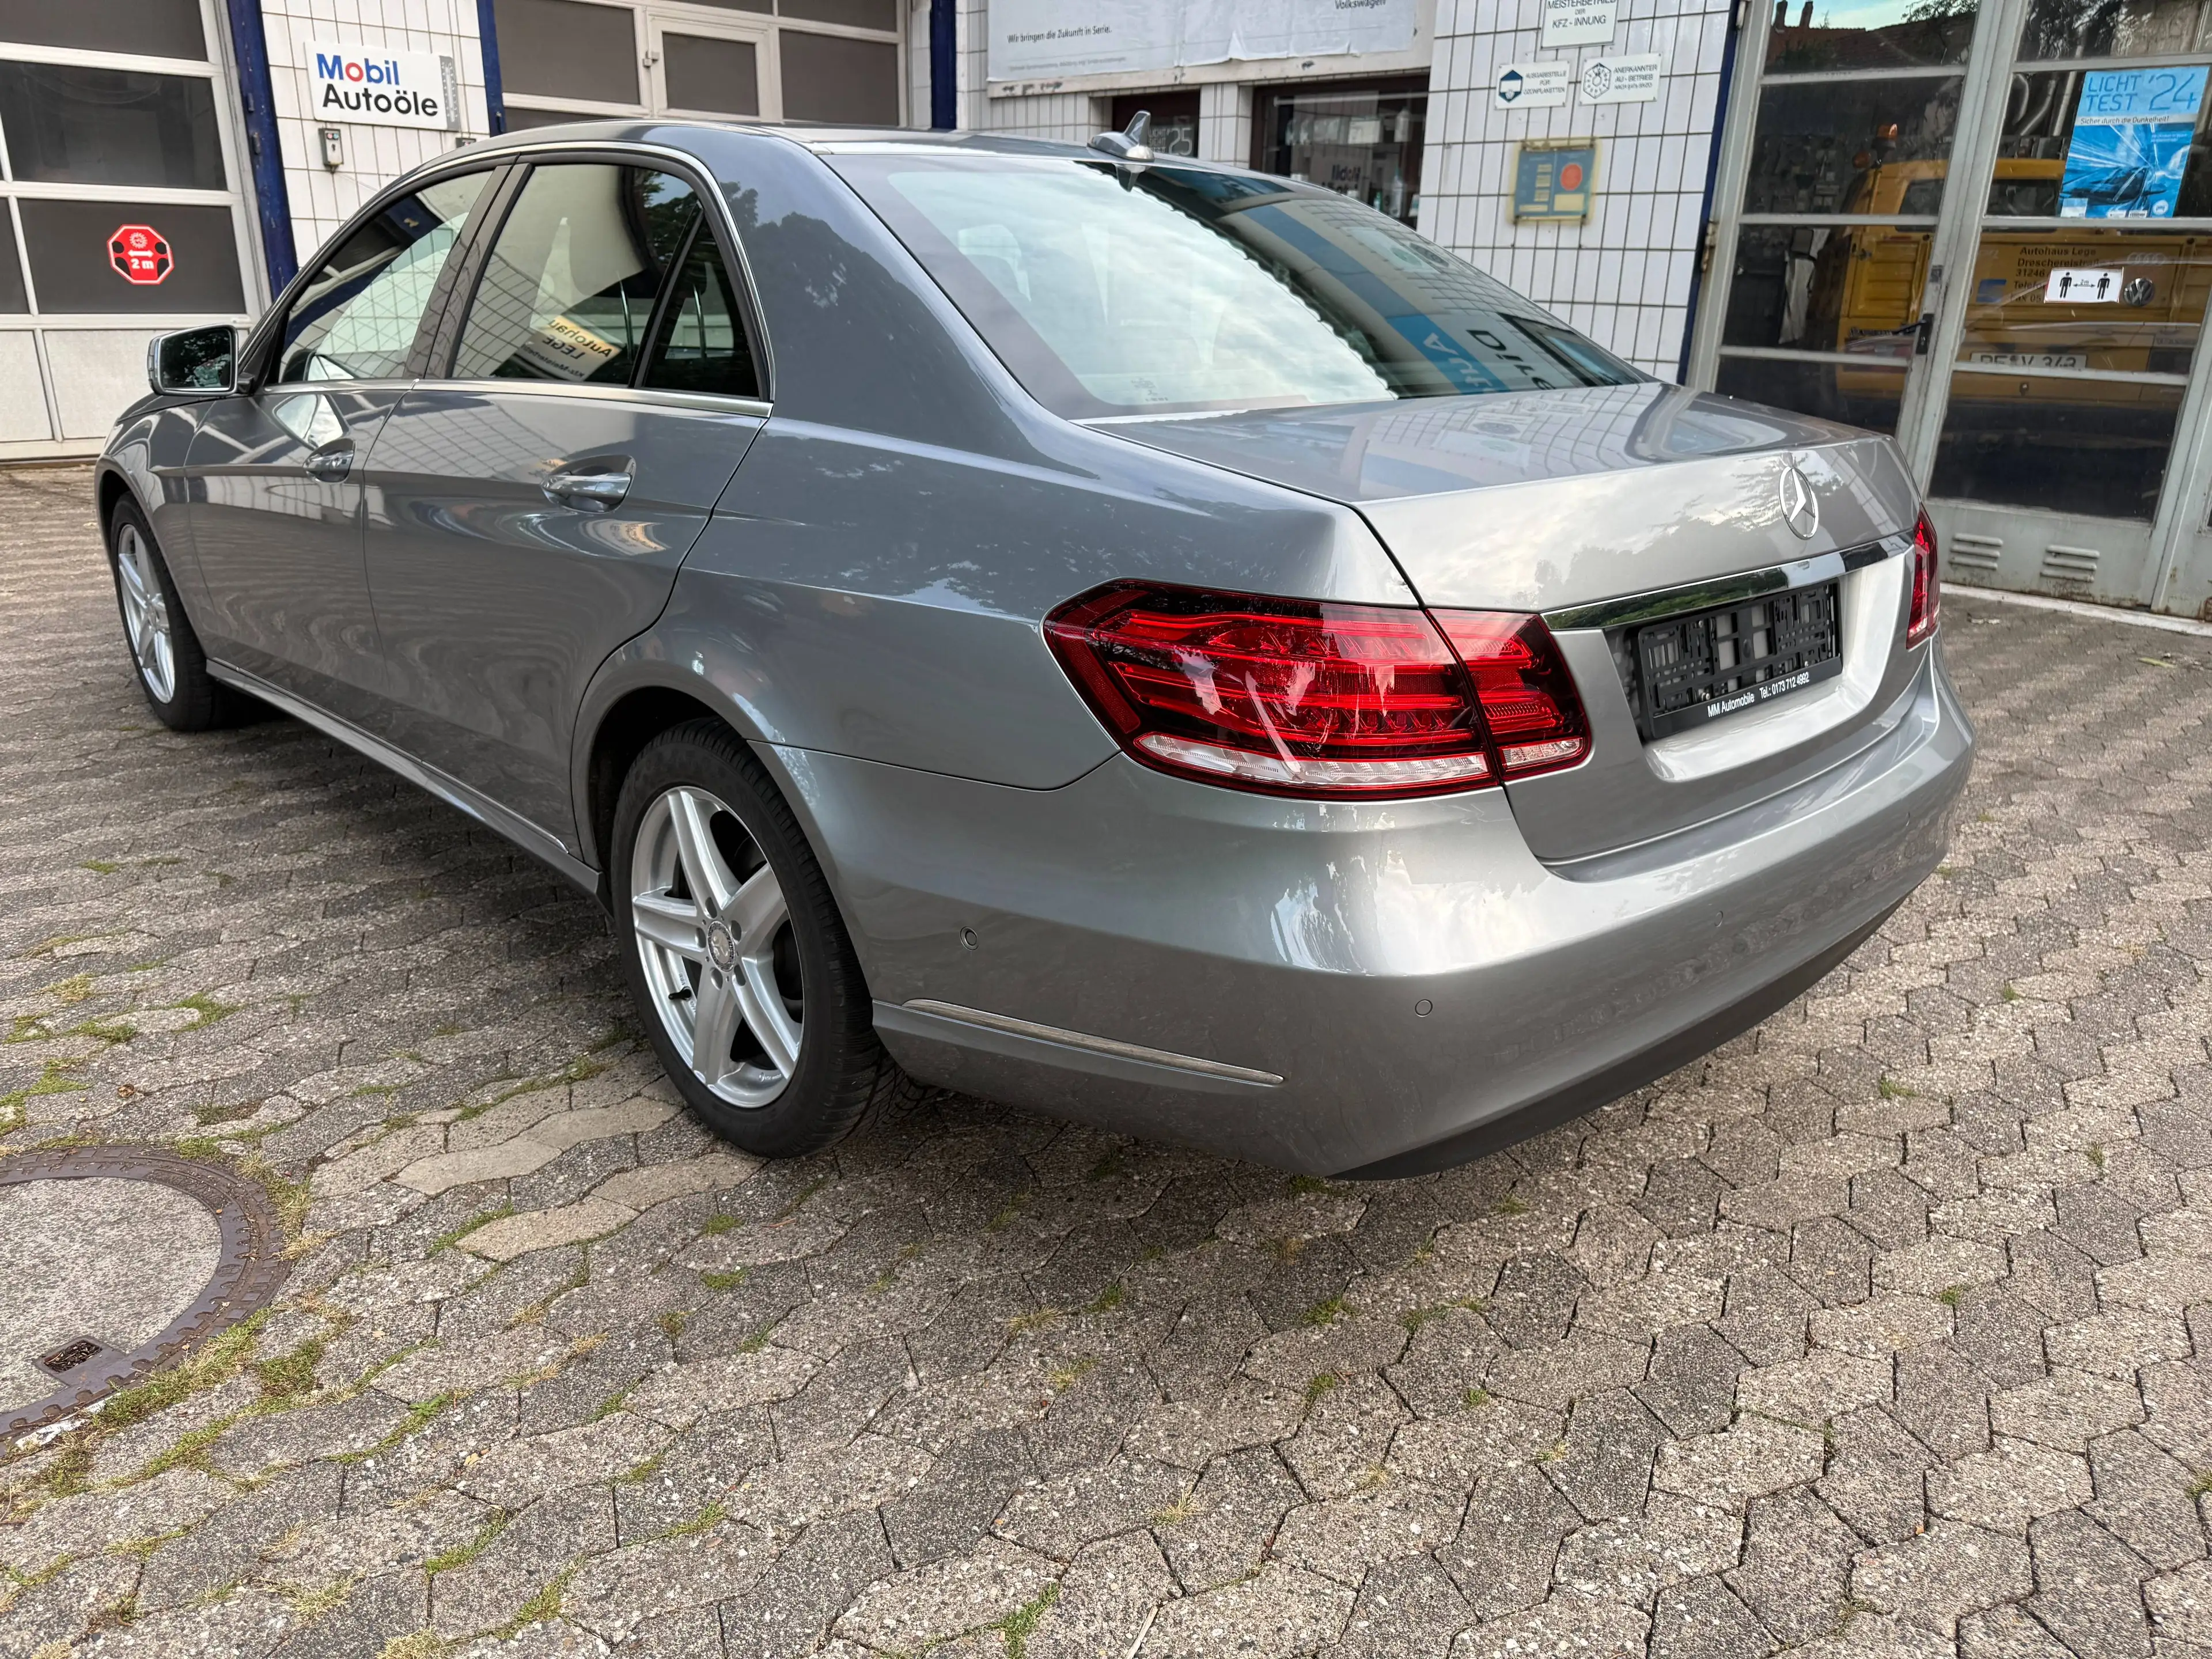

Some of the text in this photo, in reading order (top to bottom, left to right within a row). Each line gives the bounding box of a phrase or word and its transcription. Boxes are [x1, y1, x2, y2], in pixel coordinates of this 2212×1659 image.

[1335, 0, 1386, 9] Volkswagen
[1552, 18, 1568, 29] KFZ
[1574, 14, 1607, 26] INNUNG
[1020, 32, 1045, 43] bringen
[1046, 31, 1056, 40] die
[1085, 26, 1092, 35] in
[316, 53, 400, 85] Mobil
[1613, 64, 1658, 73] ANERKANNTER
[2088, 75, 2142, 92] LICHT
[323, 84, 438, 116] Autoöle
[2086, 93, 2138, 112] TEST
[2081, 117, 2100, 125] Sicher
[2101, 116, 2120, 124] durch
[2020, 247, 2096, 257] Autohaus Lege
[130, 257, 154, 270] 2 m
[2016, 268, 2045, 277] 31246
[1707, 671, 1810, 718] MM Automobile Tel.: 0173 712 4992
